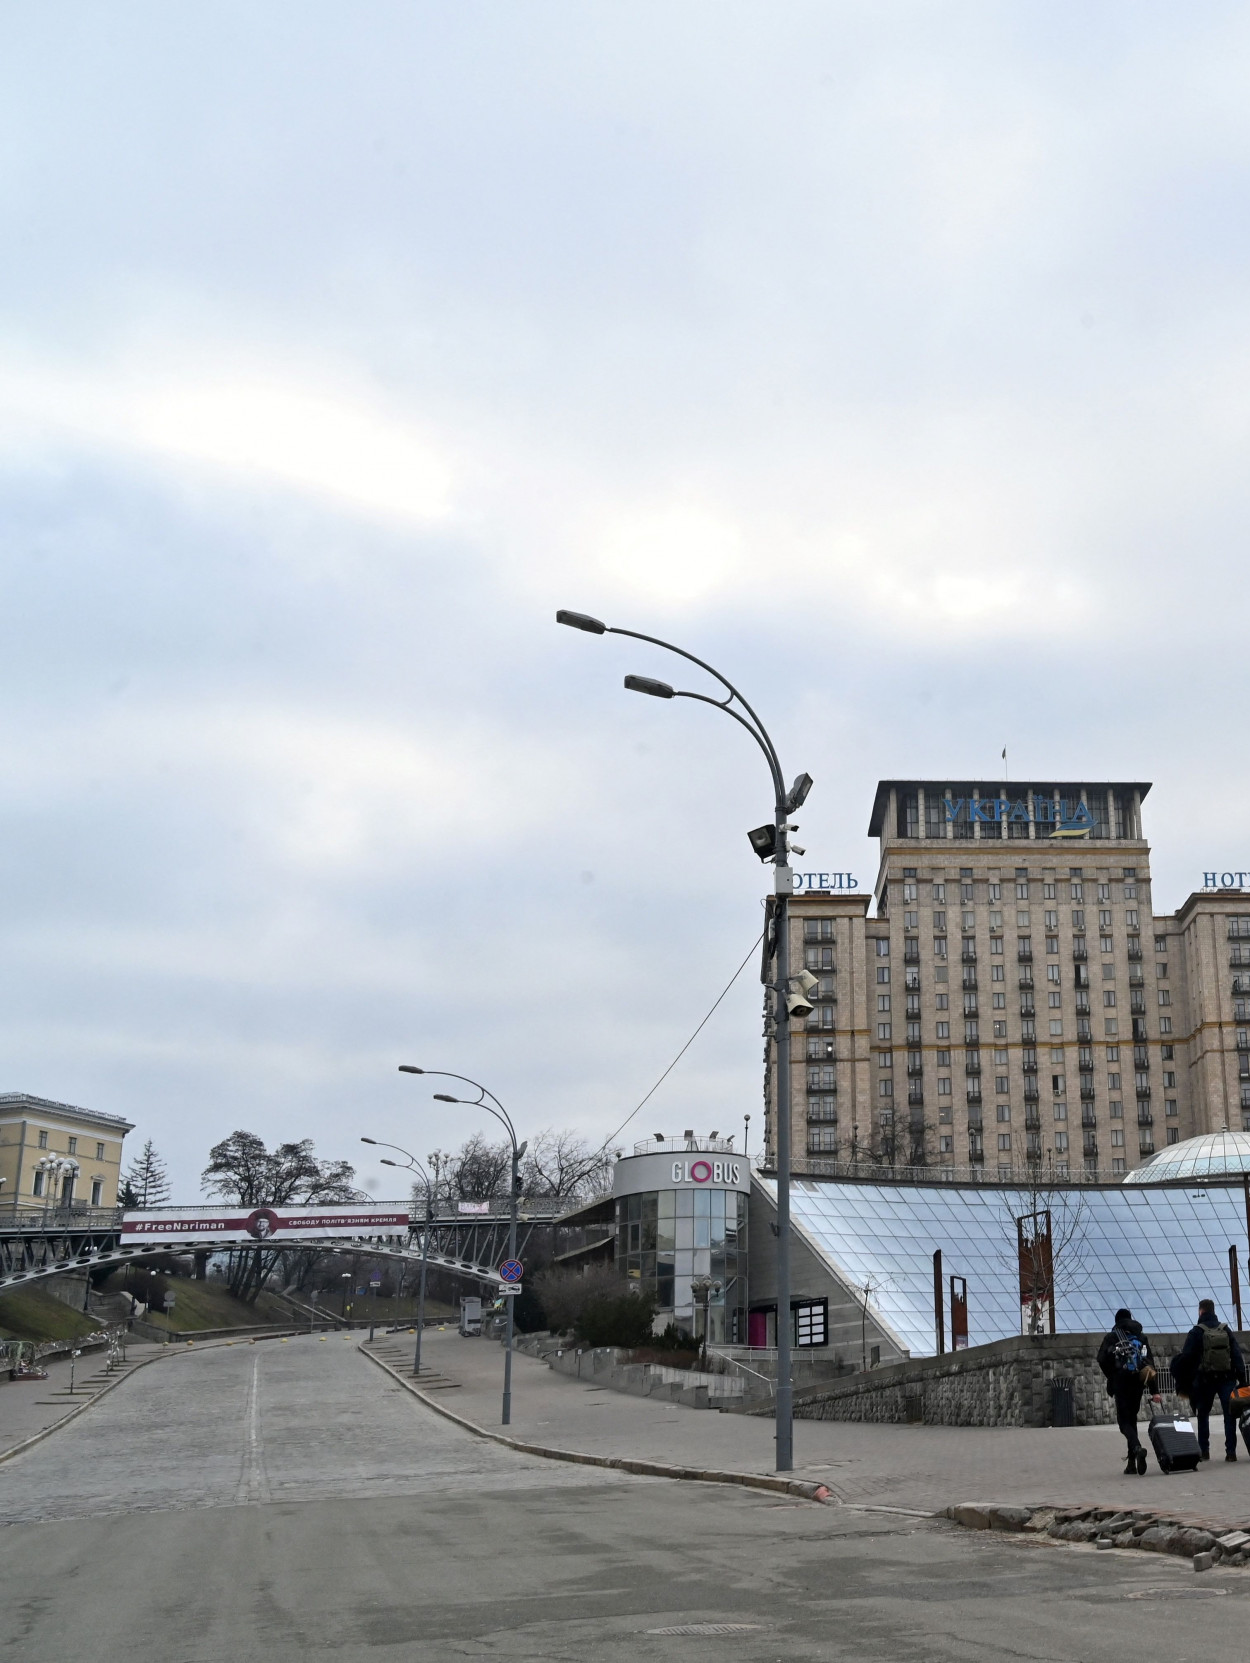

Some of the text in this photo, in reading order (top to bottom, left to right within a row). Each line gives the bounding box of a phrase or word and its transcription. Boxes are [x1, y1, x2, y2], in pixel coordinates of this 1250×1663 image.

[942, 795, 1094, 821] УКРАЇНА
[671, 1160, 740, 1184] GLOBUS
[135, 1221, 225, 1231] #FreeNariman
